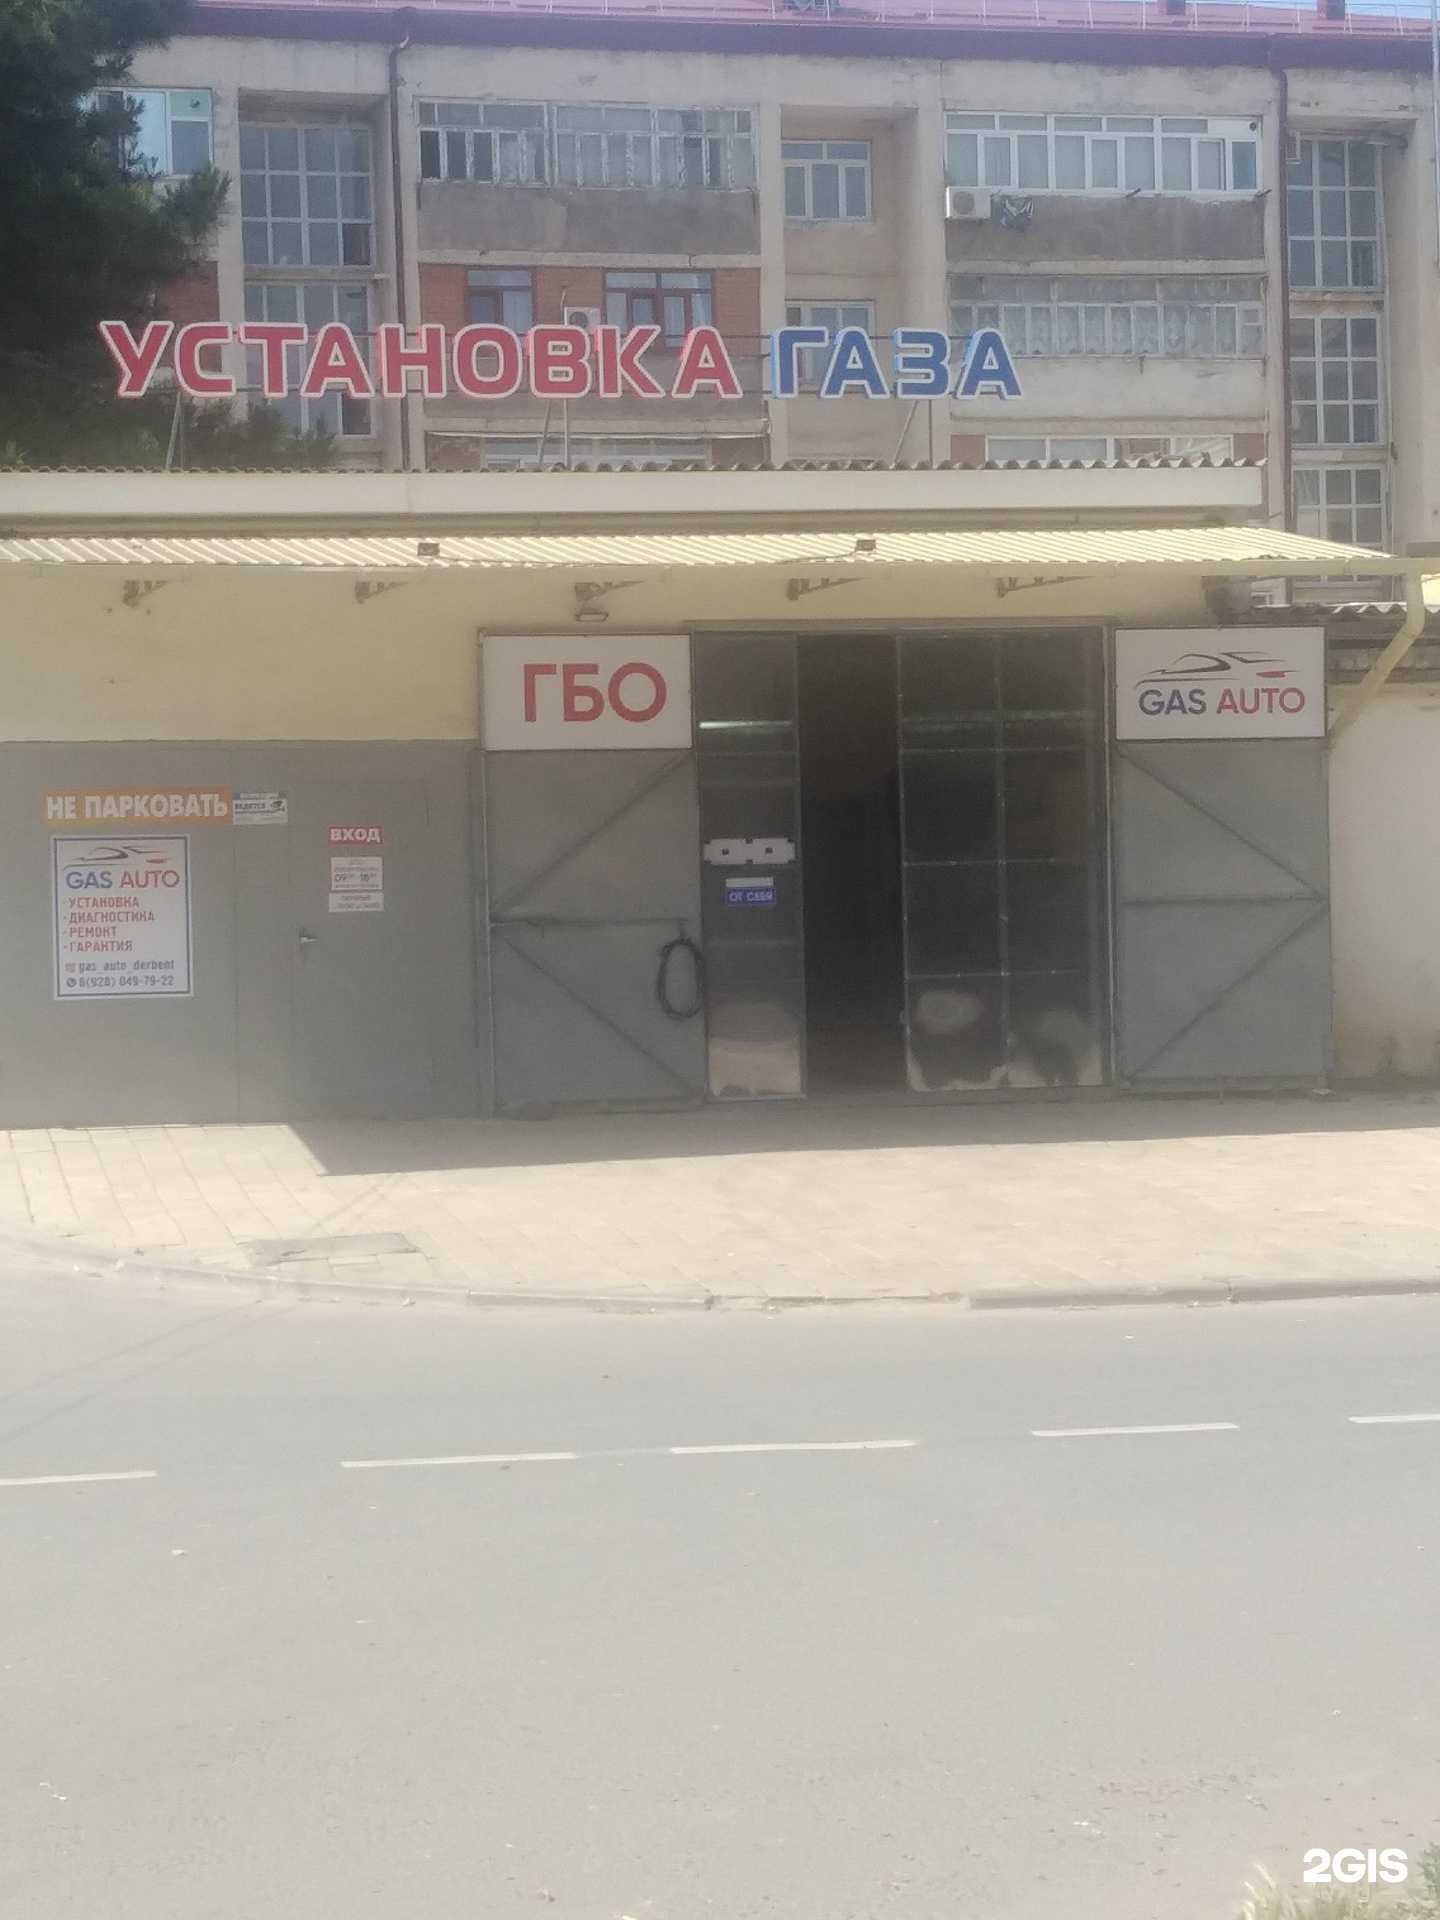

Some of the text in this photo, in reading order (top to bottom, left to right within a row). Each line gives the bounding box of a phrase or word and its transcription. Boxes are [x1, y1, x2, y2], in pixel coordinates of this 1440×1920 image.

[98, 320, 1022, 401] УСТАНОВКА ГАЗА
[523, 662, 667, 723] ГБО
[1138, 687, 1305, 715] GAS AUTO
[47, 793, 229, 819] НЕ ПАРКОВАТЬ
[330, 828, 381, 842] ВХОД
[66, 869, 180, 889] GAS AUTO
[68, 896, 140, 908] УСТАНОВКА
[69, 911, 155, 923] ДИАГНОСТИКА
[69, 926, 118, 938] РЕМОНТ
[69, 940, 134, 952] ГАРАНТИЯ
